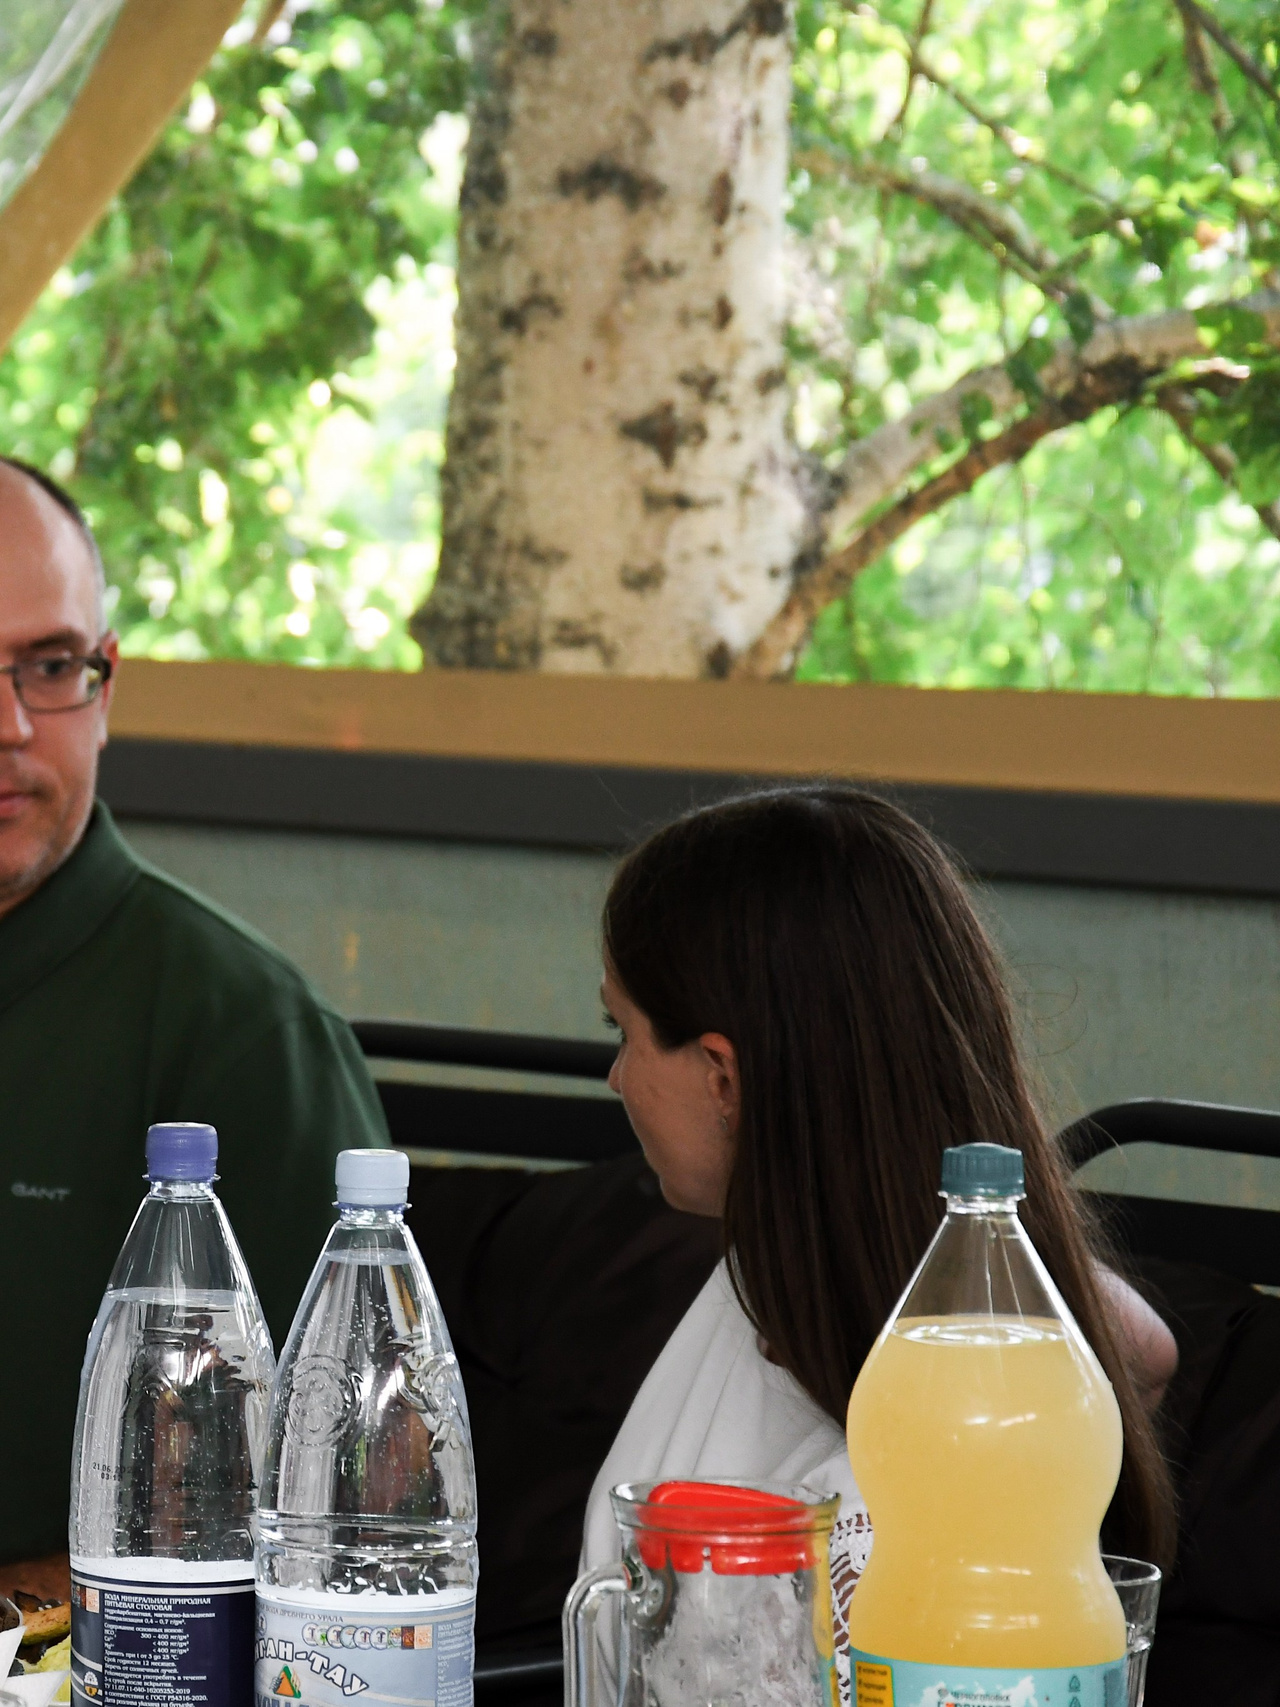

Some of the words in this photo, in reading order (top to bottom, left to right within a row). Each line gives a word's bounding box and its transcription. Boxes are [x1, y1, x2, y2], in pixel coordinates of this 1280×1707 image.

[104, 1593, 120, 1601] ВОДА
[121, 1595, 168, 1605] МИНЕРАЛЬНАЯ
[104, 1600, 135, 1609] ПИТЬЕВАЯ
[256, 1638, 369, 1696] ГАН-ТАУ
